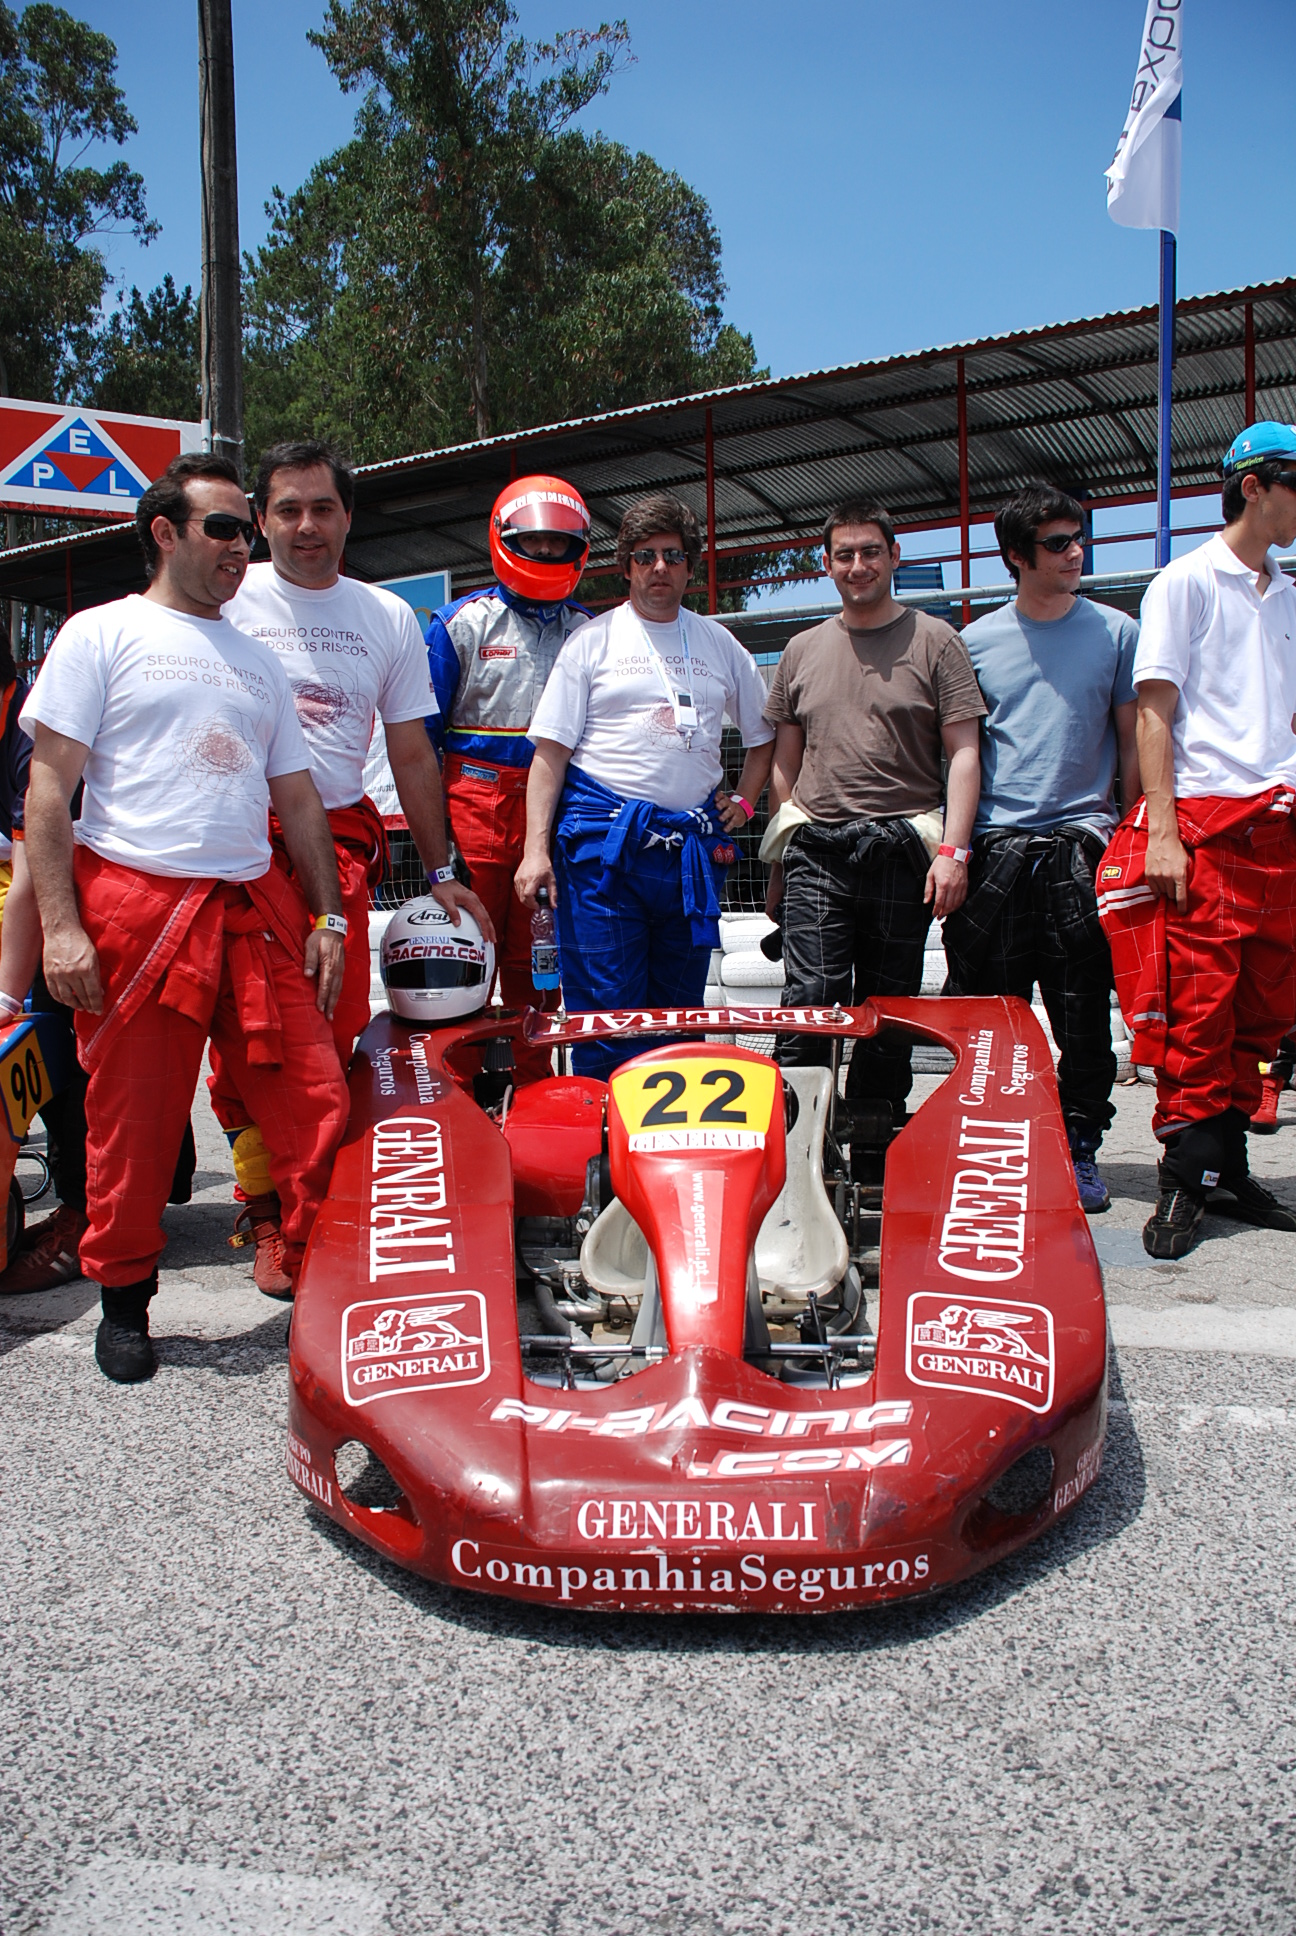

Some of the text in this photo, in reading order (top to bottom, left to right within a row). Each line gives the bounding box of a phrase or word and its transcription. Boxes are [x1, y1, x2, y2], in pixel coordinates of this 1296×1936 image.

[69, 428, 91, 454] E
[1241, 440, 1251, 453] 2
[33, 462, 130, 496] P L
[251, 627, 364, 642] SEGURO CONTRA
[261, 640, 368, 657] DOS OS RISCOS
[147, 654, 266, 686] SEGURO CONTRA
[615, 666, 653, 677] TODOS
[675, 667, 714, 678] RICO
[617, 655, 662, 667] SEGU
[142, 670, 271, 702] TODOS OS RISCOS
[412, 910, 449, 921] Arai
[409, 936, 450, 945] GENERALI
[11, 1047, 42, 1121] 90
[370, 1047, 399, 1096] Seguros
[405, 1033, 442, 1104] Companhia
[959, 1029, 994, 1106] Companhia
[1000, 1044, 1034, 1096] Seguros
[640, 1069, 747, 1128] 22
[634, 1132, 758, 1149] GENERALI
[690, 1171, 711, 1276] www.generali.pt
[353, 1351, 479, 1386] GENERALI
[917, 1353, 1044, 1394] GENERALI
[287, 1450, 333, 1508] ERALI
[577, 1499, 819, 1541] GENERALI
